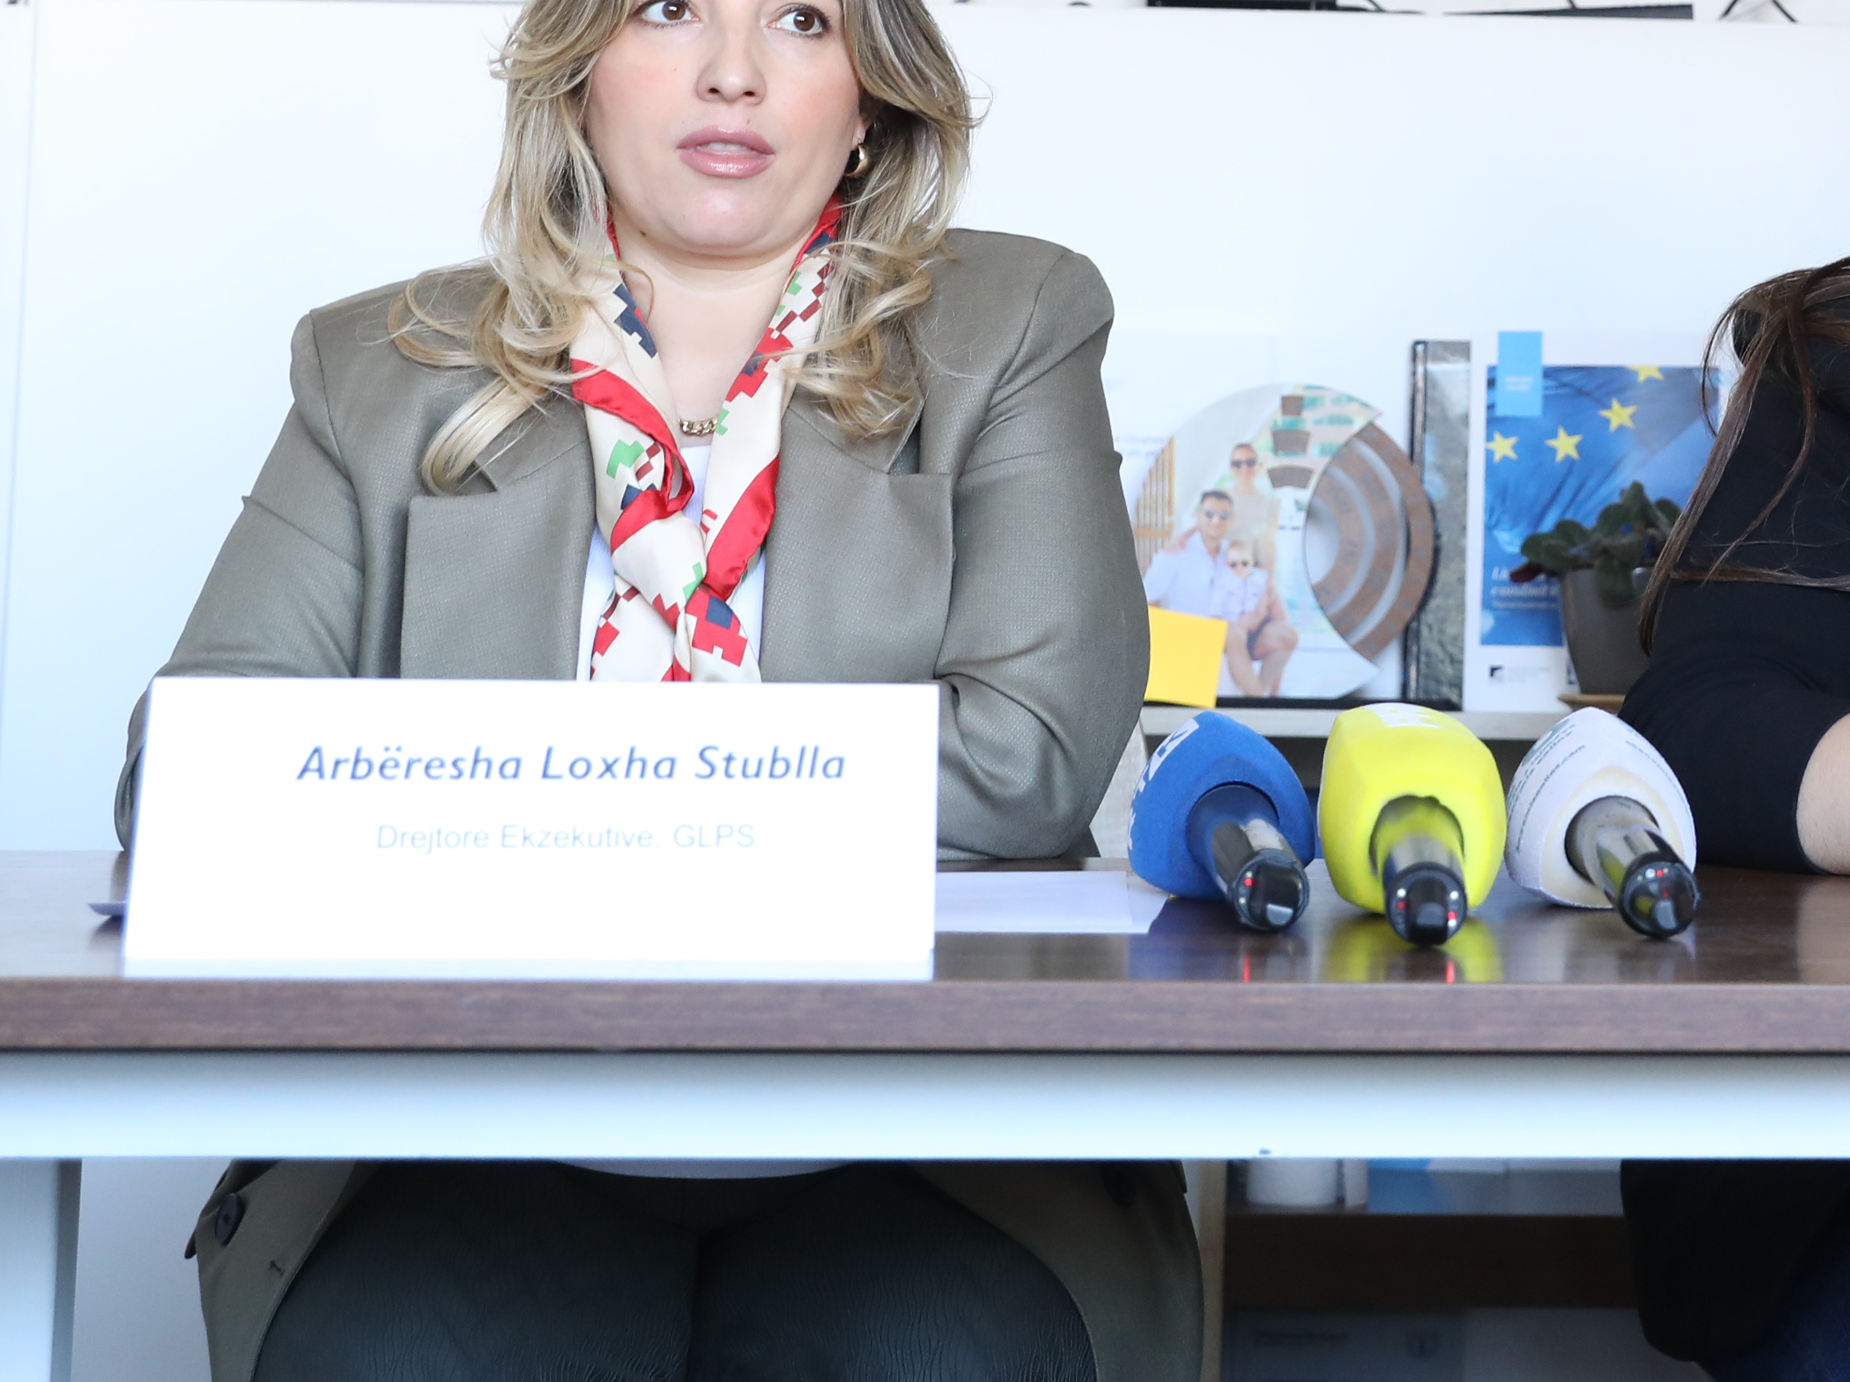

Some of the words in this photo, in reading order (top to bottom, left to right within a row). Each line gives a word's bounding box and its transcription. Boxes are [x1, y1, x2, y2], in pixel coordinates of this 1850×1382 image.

[296, 745, 523, 781] Arbëresha
[541, 745, 678, 781] Loxha
[694, 744, 846, 781] Stublla
[376, 824, 490, 855] Drejtore
[672, 823, 755, 849] GLPS
